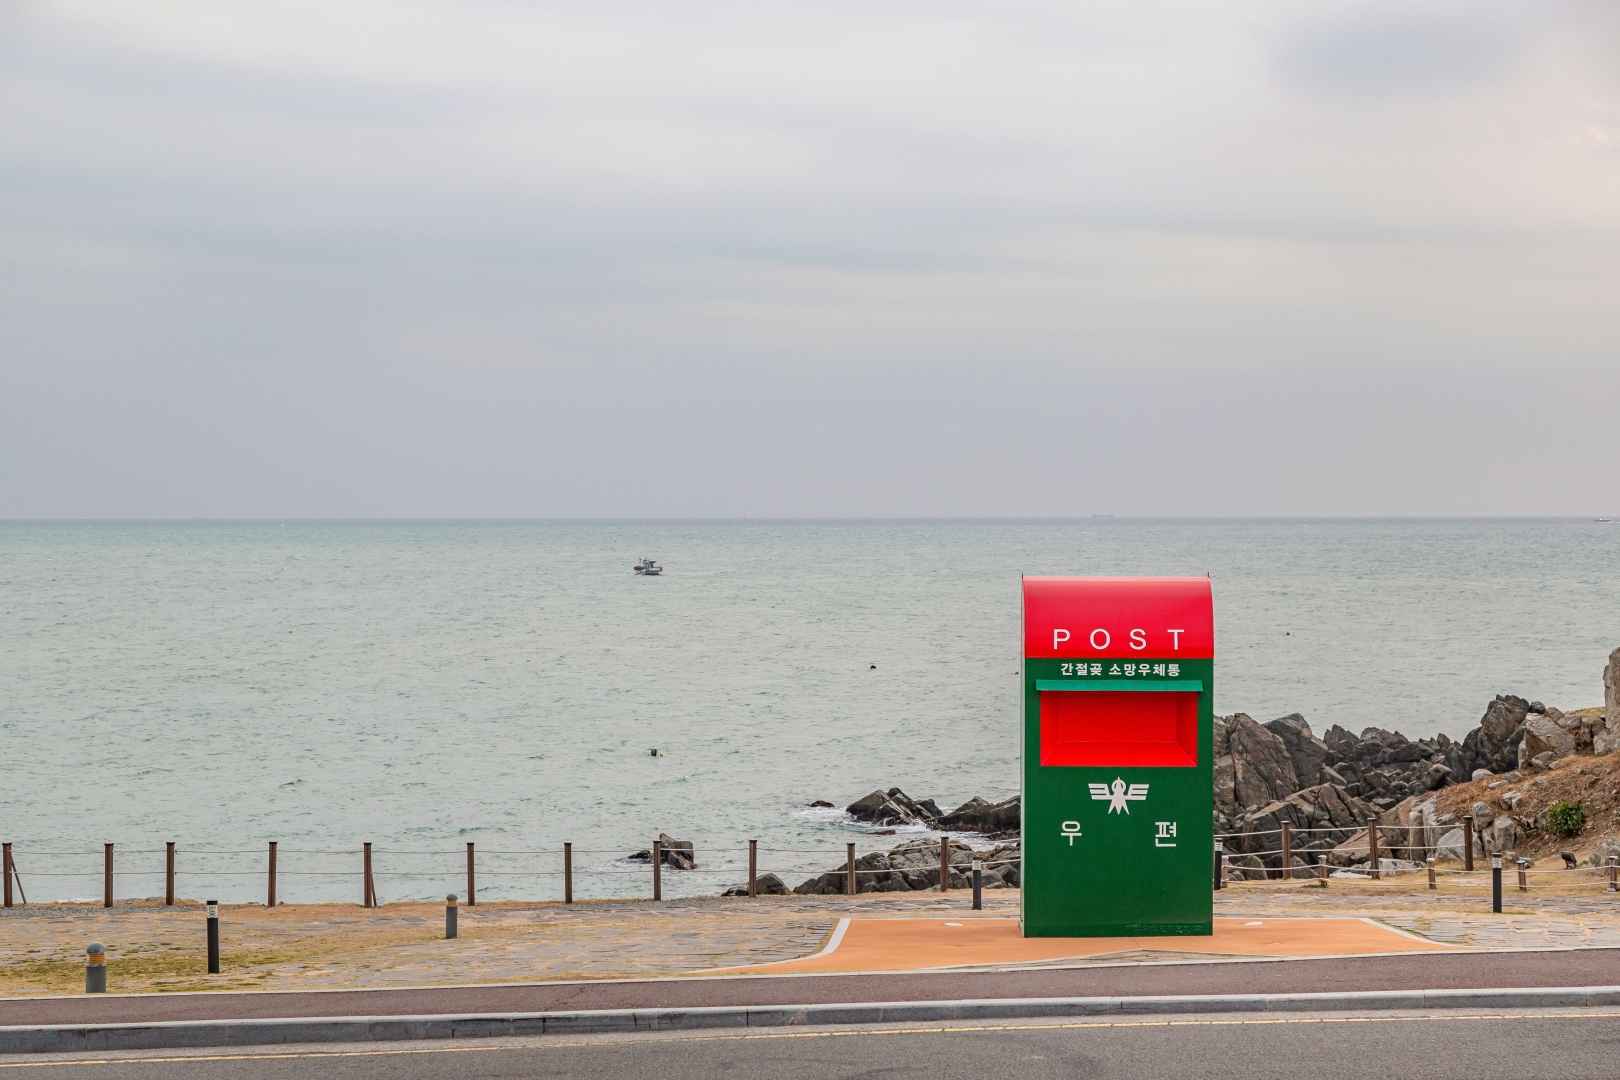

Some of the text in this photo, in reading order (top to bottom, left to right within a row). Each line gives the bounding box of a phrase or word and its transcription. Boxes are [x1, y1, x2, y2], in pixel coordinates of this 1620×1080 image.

[1053, 628, 1185, 651] POST
[1060, 663, 1181, 677] 간절곶 소망우체통
